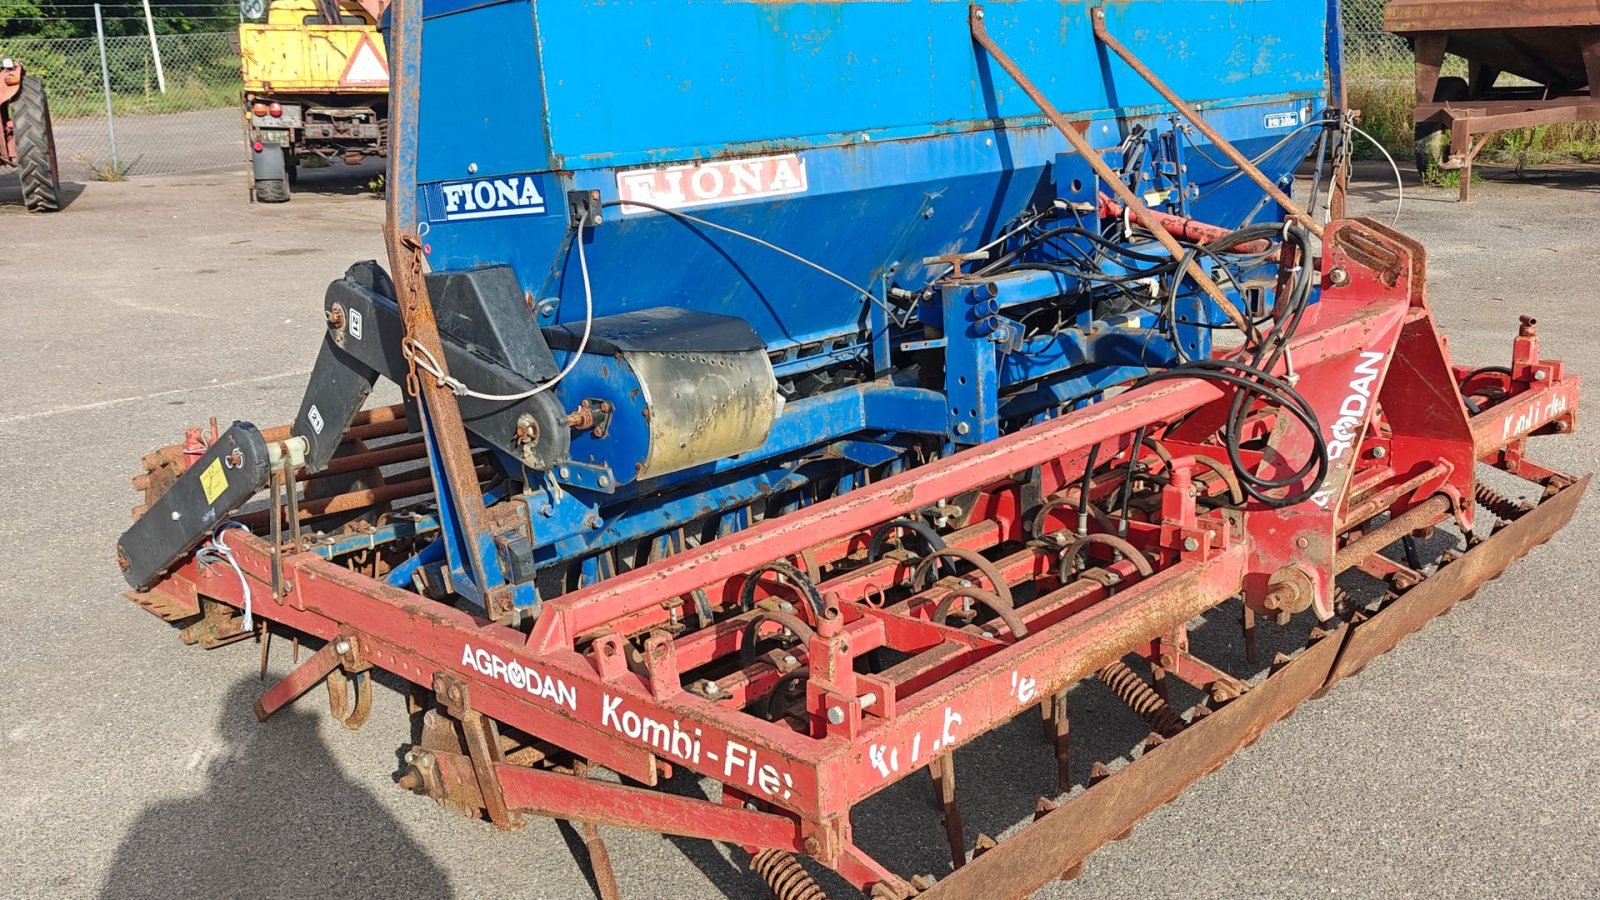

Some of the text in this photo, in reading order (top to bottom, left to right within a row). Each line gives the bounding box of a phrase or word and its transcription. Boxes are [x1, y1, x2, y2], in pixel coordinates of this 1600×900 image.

[443, 176, 543, 212] FIONA
[624, 157, 802, 202] FIONA
[352, 316, 359, 333] 21
[312, 413, 321, 428] 21
[1310, 350, 1385, 509] ARODAN
[462, 643, 577, 712] AGRODAN
